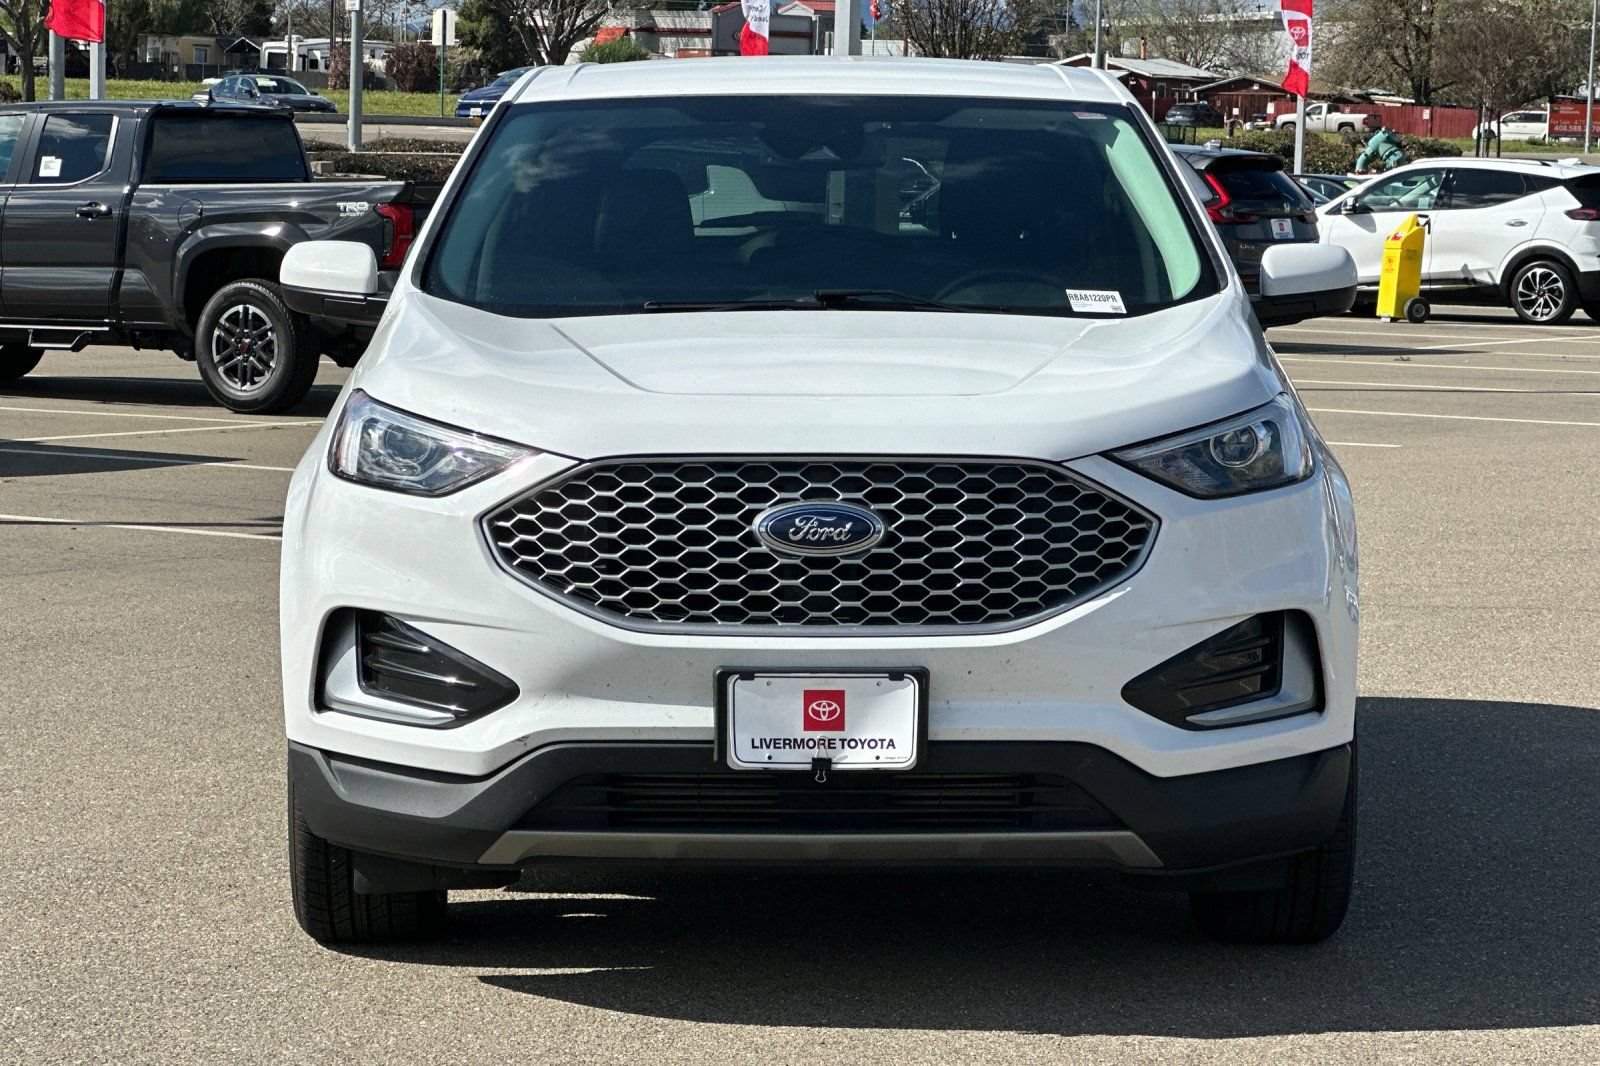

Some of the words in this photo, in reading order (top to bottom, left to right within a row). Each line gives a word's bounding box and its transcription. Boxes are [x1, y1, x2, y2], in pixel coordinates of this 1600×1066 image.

[336, 201, 369, 212] TRD
[788, 515, 853, 541] Ford
[751, 738, 837, 750] LIVERMORE
[841, 738, 896, 750] TOYOTA
